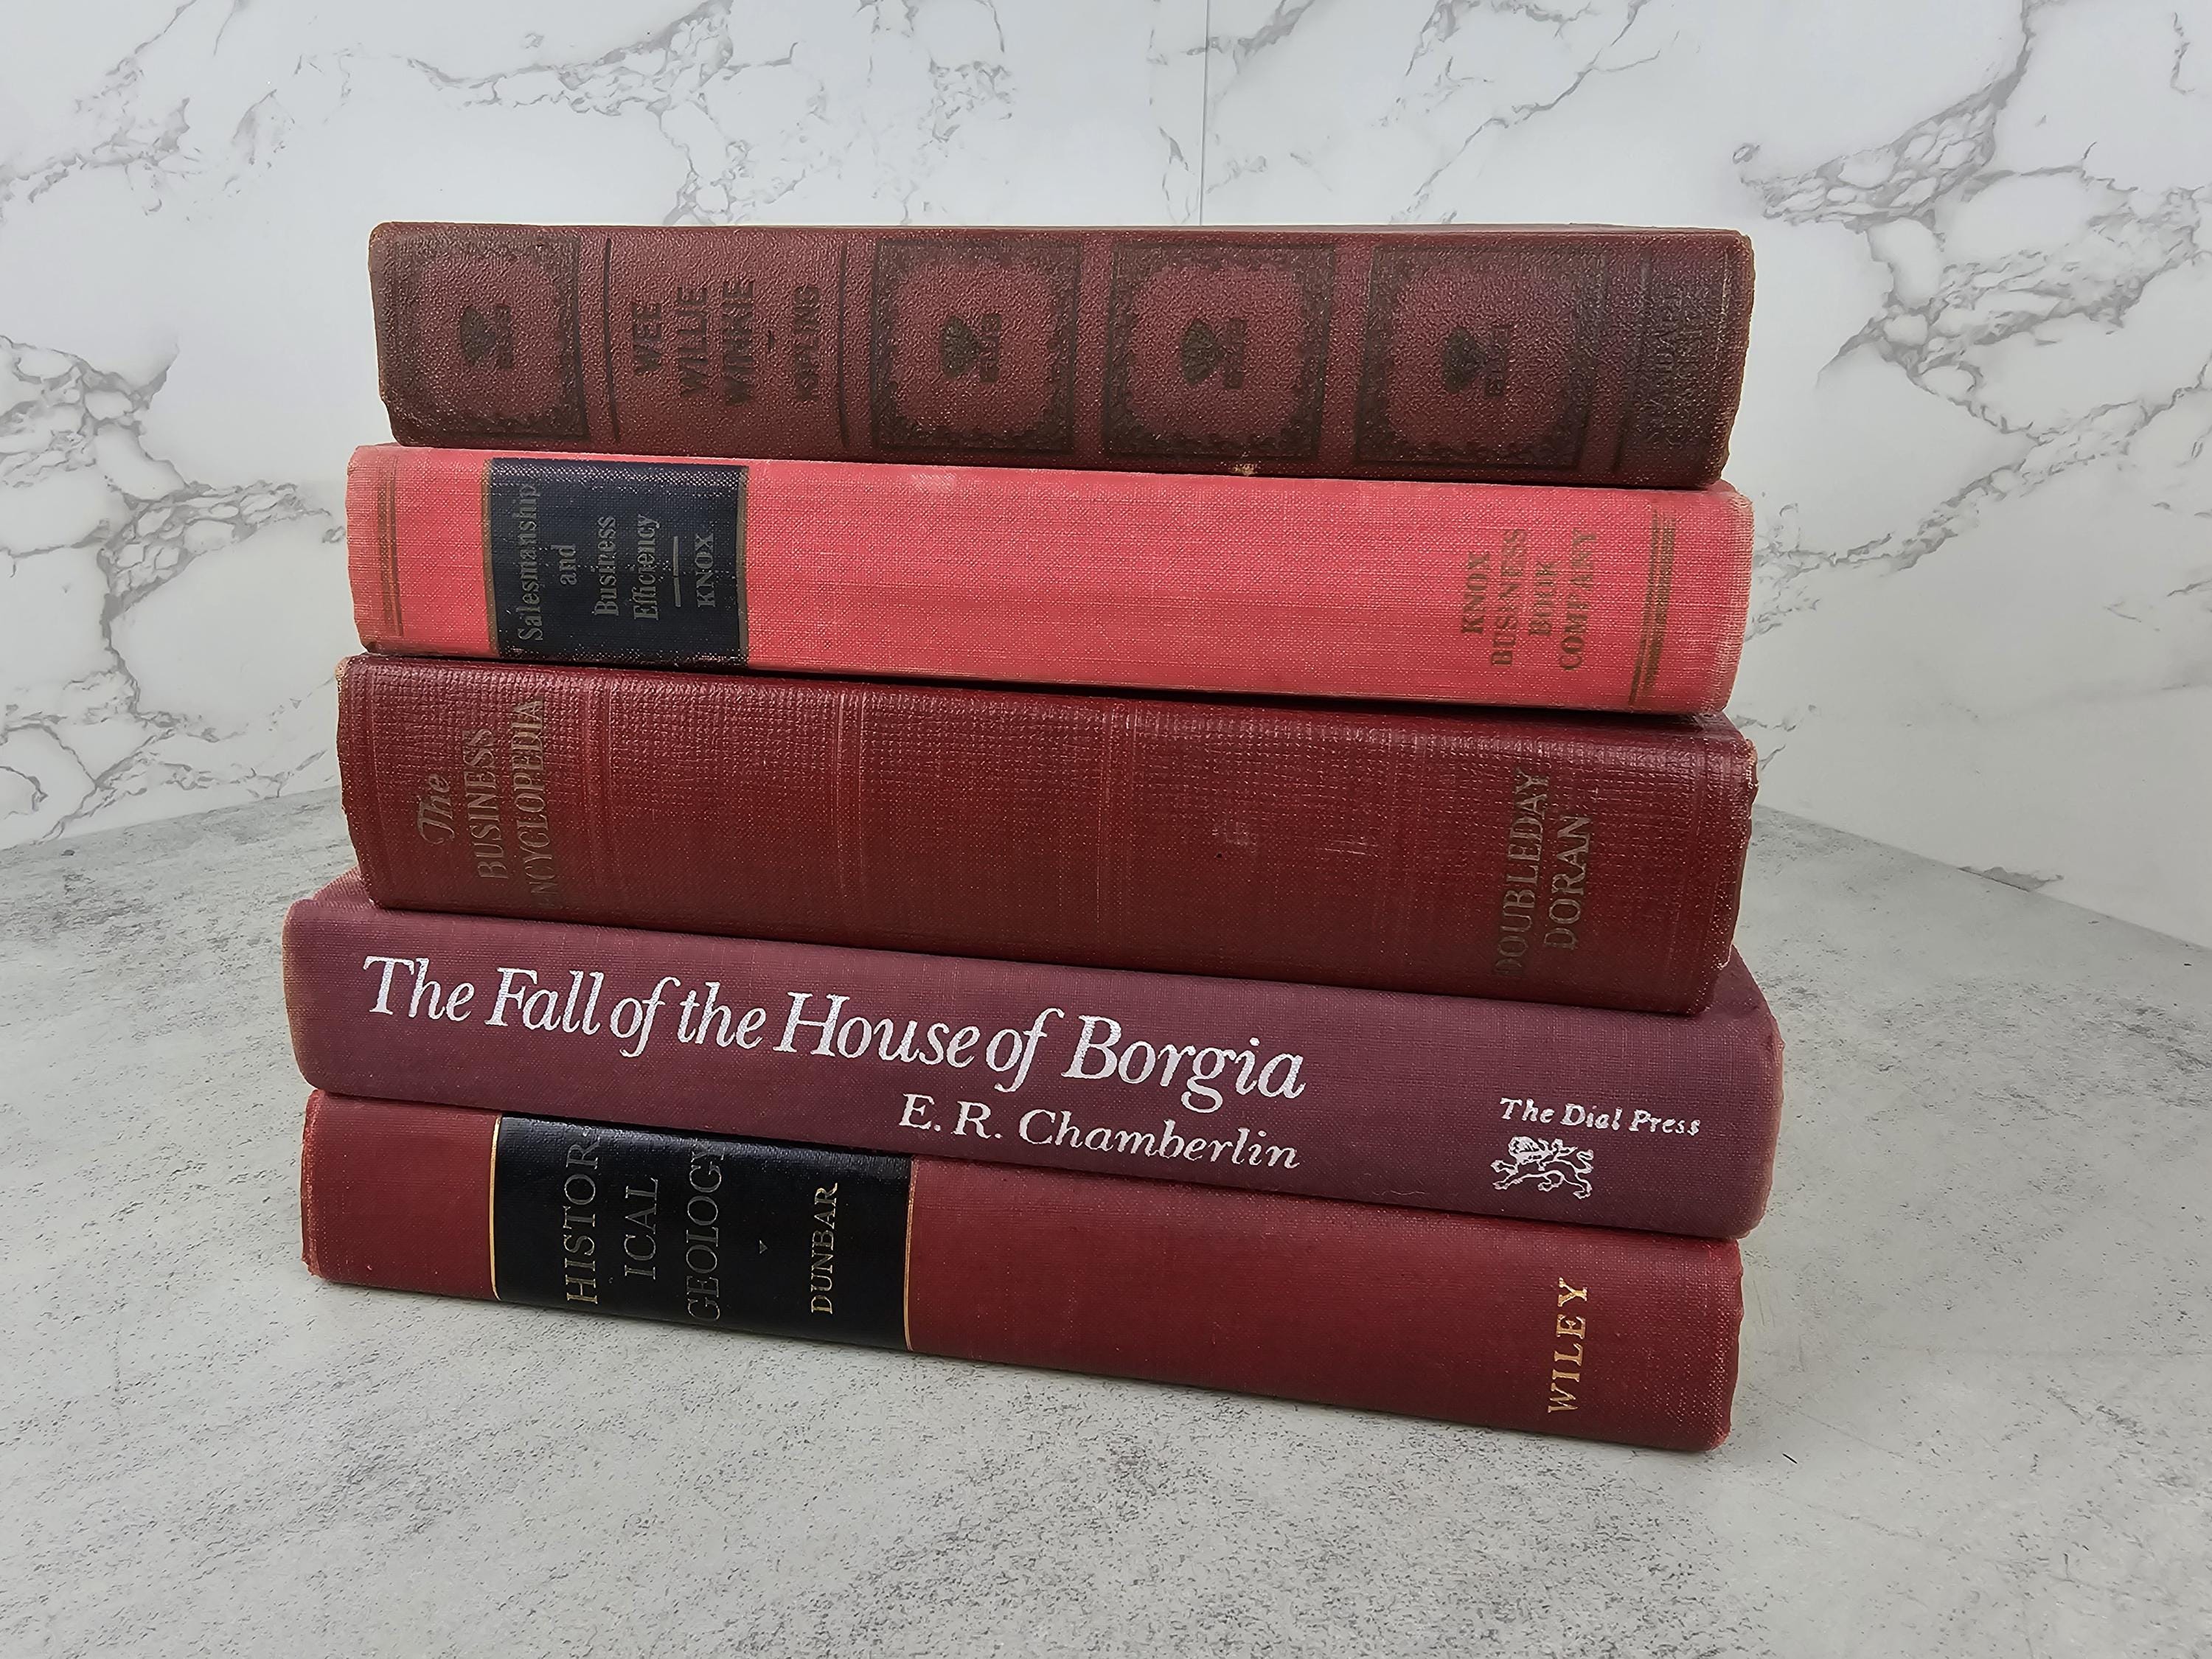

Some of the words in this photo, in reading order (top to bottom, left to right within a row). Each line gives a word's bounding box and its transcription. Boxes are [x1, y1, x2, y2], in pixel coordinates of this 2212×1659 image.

[630, 301, 662, 375] WEE
[675, 285, 709, 399] WILLIE
[720, 278, 755, 408] WINKIE
[515, 481, 544, 641] Salesmanship
[550, 543, 578, 587] and
[591, 515, 620, 616] Business
[631, 513, 661, 622] Efficiency
[694, 532, 717, 608] KNOX
[1460, 550, 1491, 636] KNOX
[1490, 527, 1528, 667] BUSINESS
[1558, 527, 1596, 671] COMPANY
[417, 774, 455, 844] The
[462, 727, 509, 880] BUSINESS
[1492, 766, 1549, 975] DOUBLEDAY
[1543, 813, 1593, 950] DORAN
[363, 955, 474, 1023] The
[484, 967, 605, 1036] Fall
[609, 975, 681, 1059] of
[677, 981, 768, 1050] the
[773, 991, 979, 1068] House
[984, 1006, 1065, 1093] of
[1061, 1014, 1307, 1113] Borgia
[898, 1093, 942, 1133] E.
[951, 1101, 1003, 1140] R.
[1018, 1108, 1300, 1170] Chamberlin
[1499, 1097, 1556, 1124] The
[1559, 1102, 1623, 1133] Dial
[1627, 1109, 1702, 1136] Press
[624, 1177, 659, 1281] ICAL
[684, 1139, 725, 1322] GEOLOGY
[810, 1181, 839, 1315] DUNBAR
[1548, 1277, 1588, 1414] WILEY
